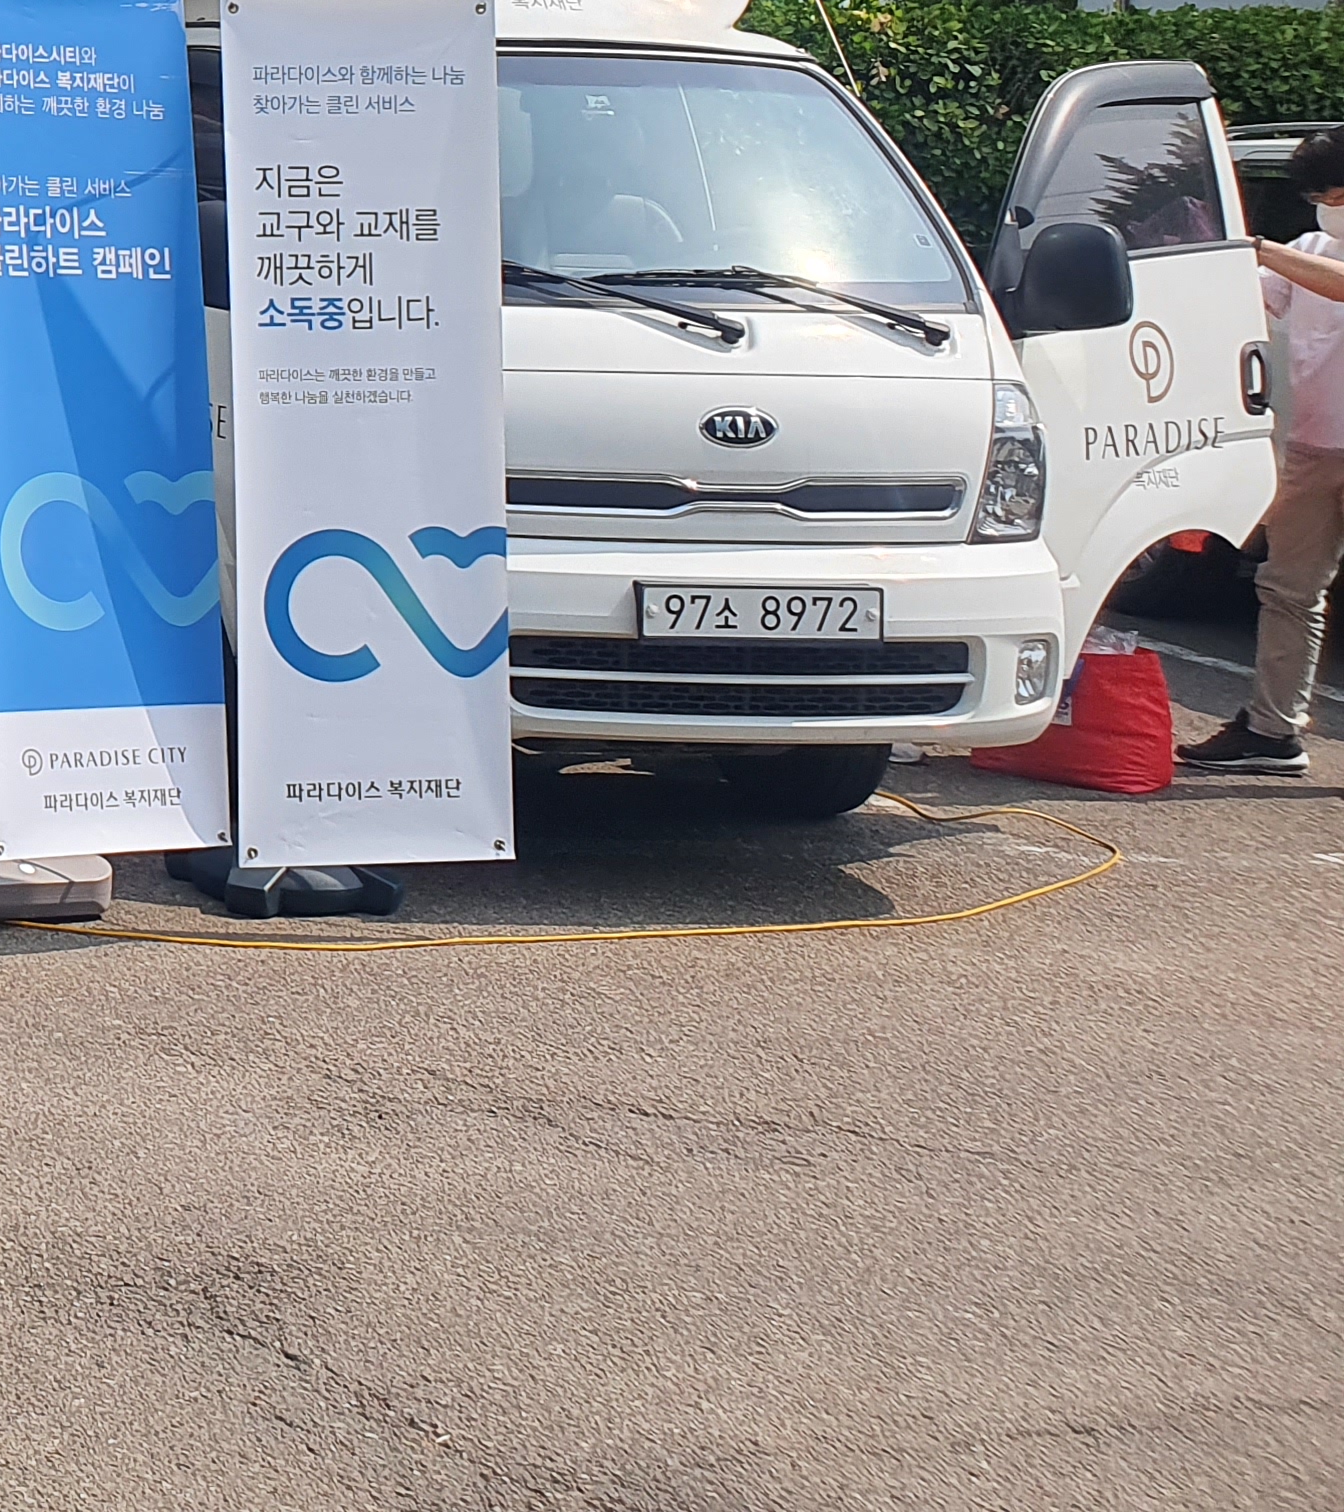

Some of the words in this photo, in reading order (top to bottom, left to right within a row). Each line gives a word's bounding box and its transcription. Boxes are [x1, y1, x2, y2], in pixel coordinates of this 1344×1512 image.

[56, 70, 135, 94] 복지재단이
[252, 65, 355, 85] 파라다이스와
[359, 65, 427, 85] 함께하는
[432, 65, 466, 85] 나눔
[42, 95, 89, 117] 깨끗한
[95, 98, 127, 119] 환경
[133, 100, 165, 120] 나눔
[253, 94, 321, 115] 찾아가는
[326, 94, 359, 115] 클린
[364, 94, 416, 115] 서비스
[45, 176, 77, 198] 클린
[84, 178, 132, 198] 서비스
[255, 164, 344, 199] 지금은
[255, 209, 345, 243] 교구와
[352, 208, 441, 243] 교재를
[92, 247, 172, 280] 캠페인
[255, 252, 374, 287] 깨끗하게
[257, 295, 440, 331] 소독중입니다.
[328, 368, 363, 382] 깨끗한
[366, 367, 399, 382] 환경을
[402, 367, 436, 381] 만들고
[259, 390, 292, 405] 행복한
[295, 390, 329, 405] 나눔을
[714, 415, 768, 439] KIA
[1084, 417, 1226, 461] PARADISE
[664, 594, 739, 630] 97소
[760, 595, 859, 632] 8972
[49, 749, 142, 770] PARADISE
[148, 746, 188, 765] CITY
[43, 790, 120, 813] 파라다이스
[123, 787, 182, 810] 복지재단
[286, 780, 382, 803] 파라다이스
[387, 778, 463, 801] 복지재단
